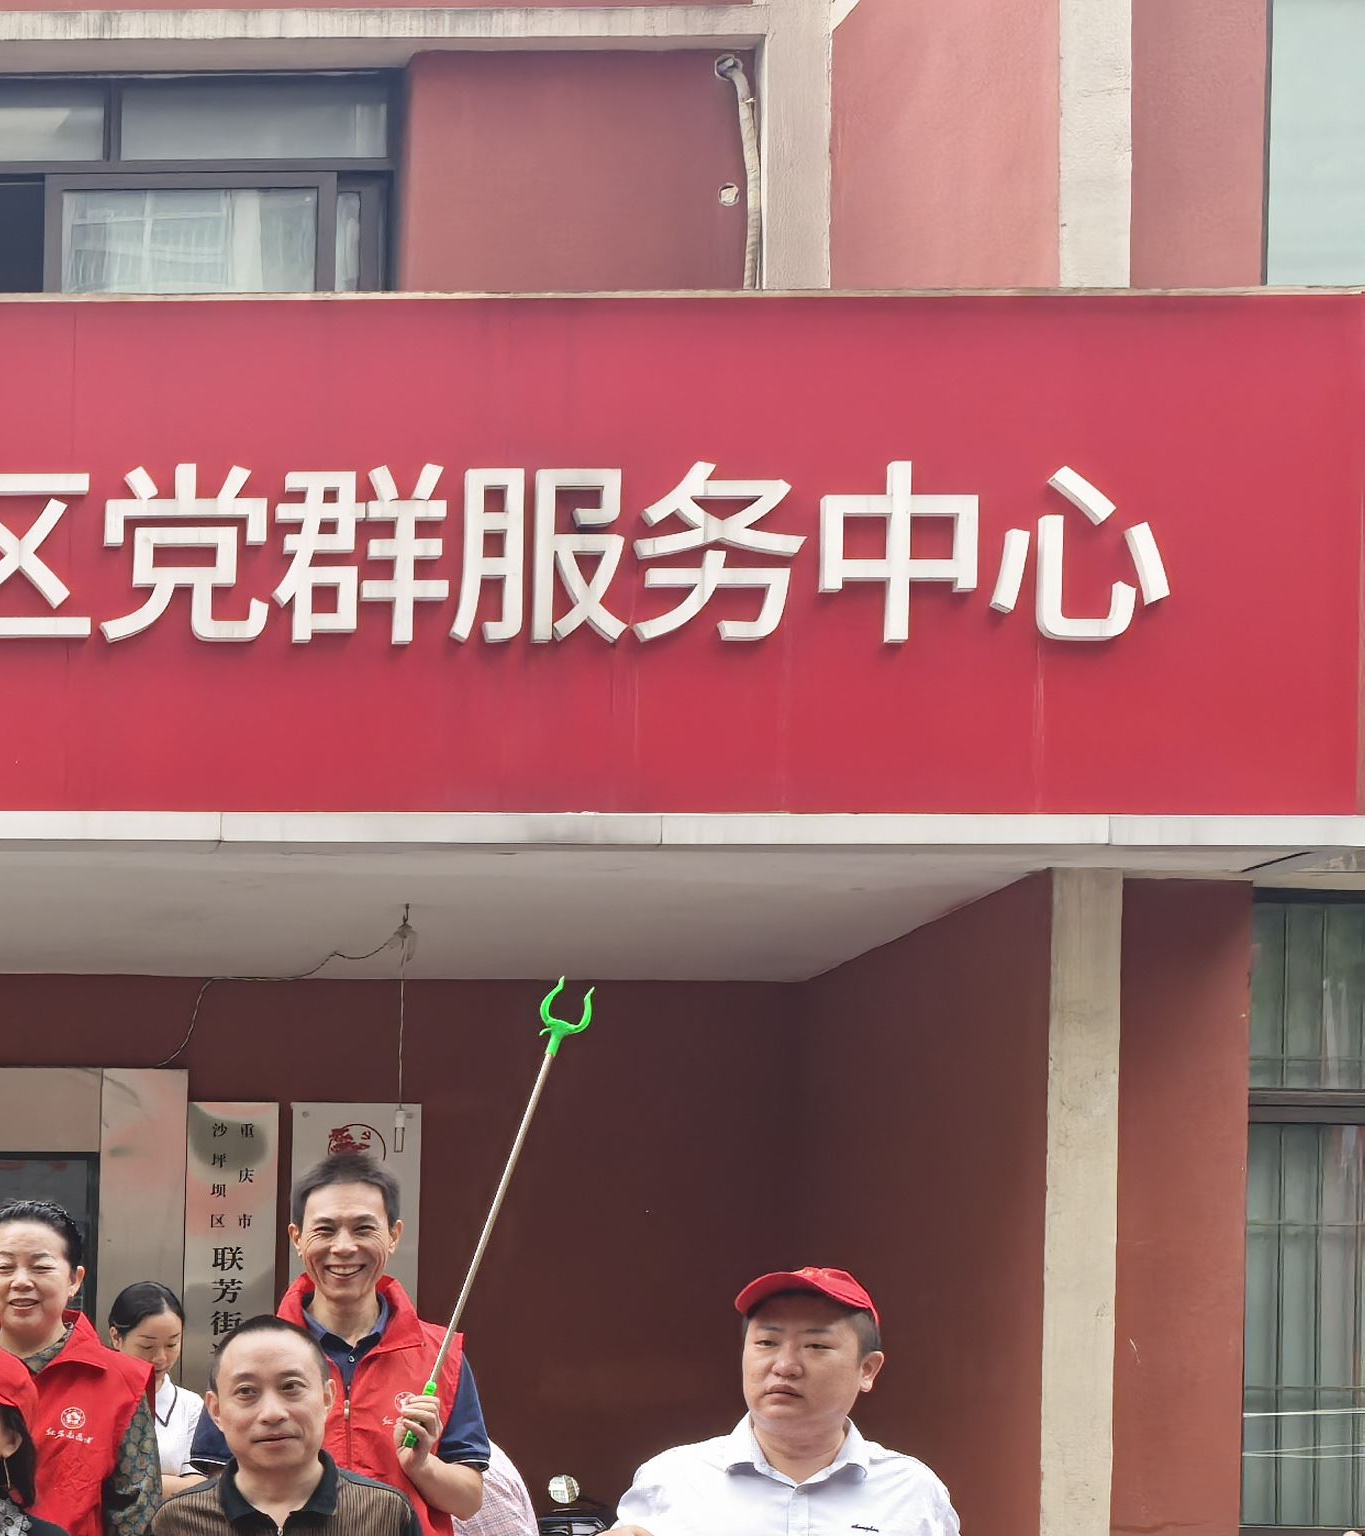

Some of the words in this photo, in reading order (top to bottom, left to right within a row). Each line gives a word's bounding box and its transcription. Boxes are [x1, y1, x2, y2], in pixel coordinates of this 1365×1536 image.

[209, 1122, 228, 1229] 沙坪坝区
[238, 1122, 255, 1229] 重庆市
[209, 1246, 245, 1360] 联芳街
